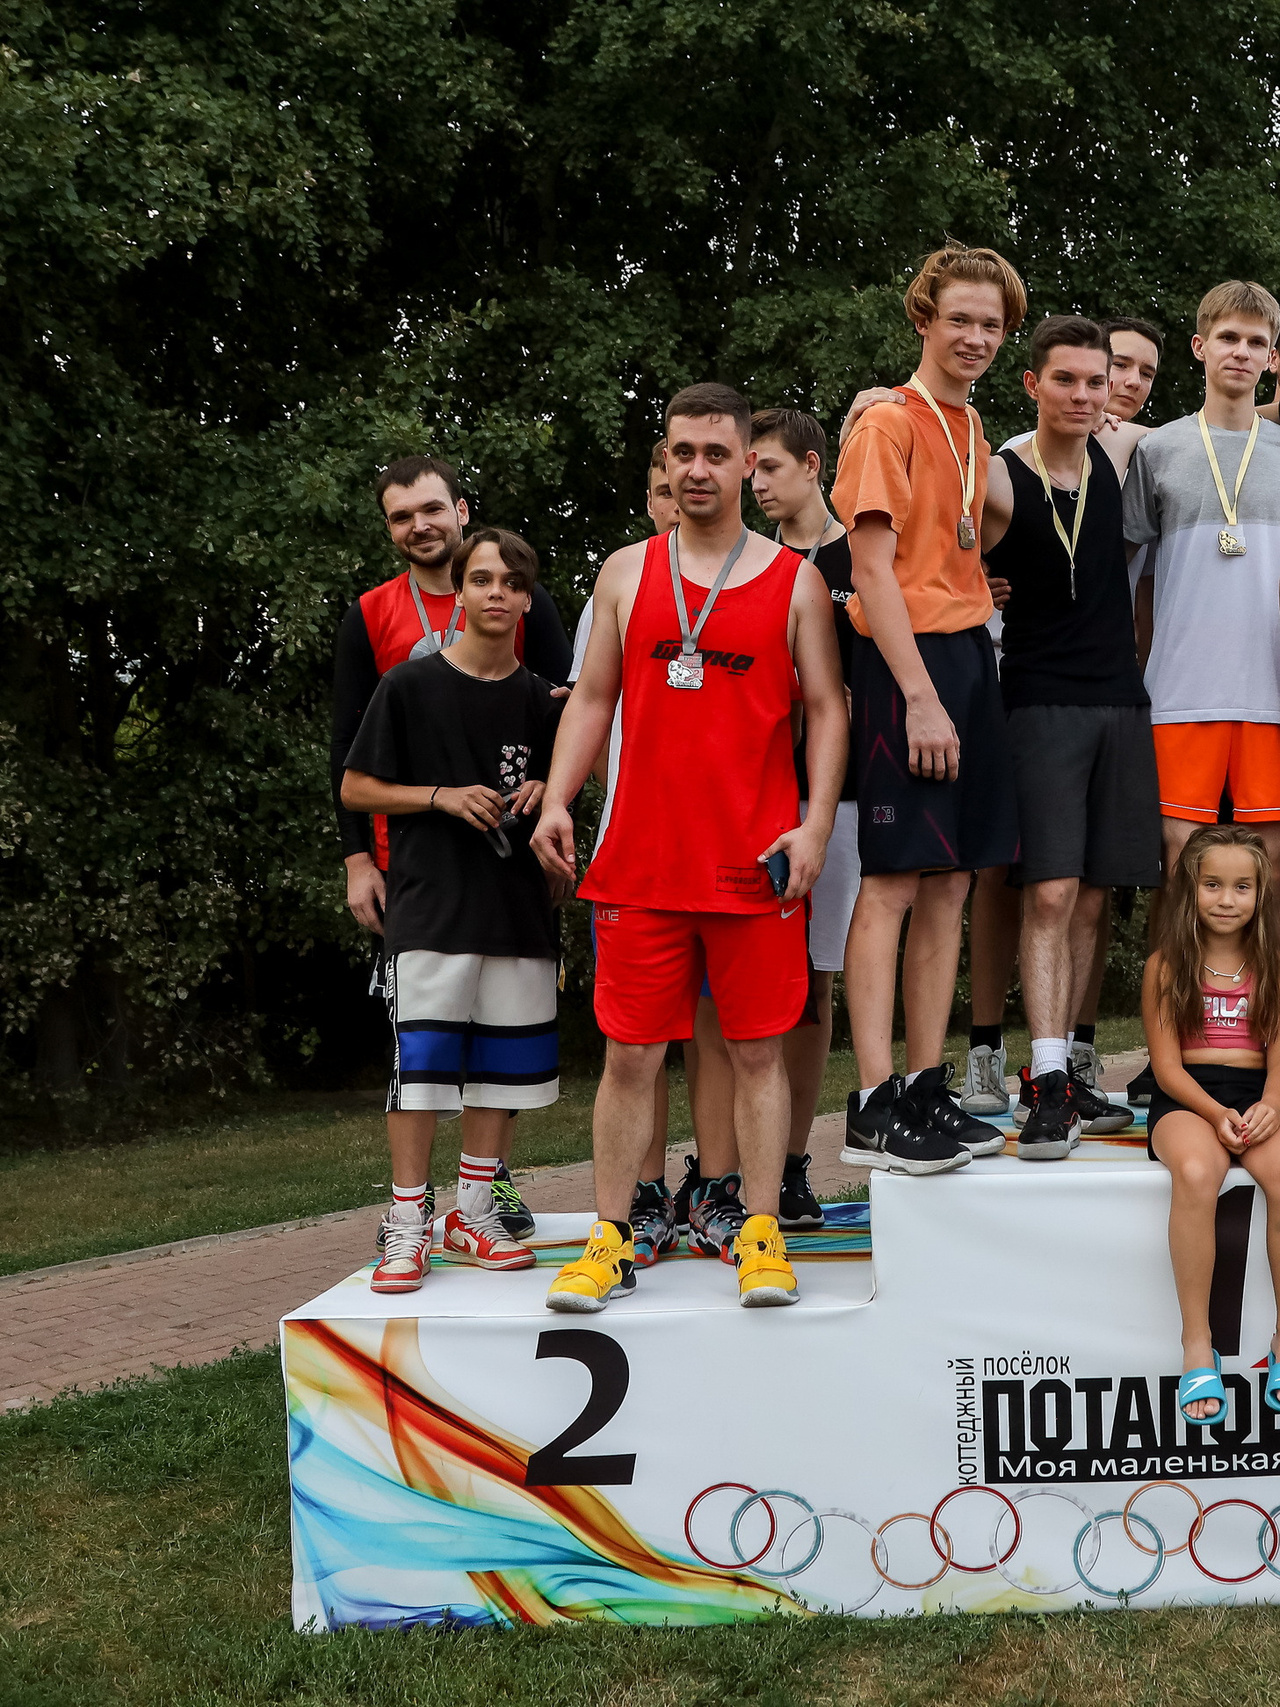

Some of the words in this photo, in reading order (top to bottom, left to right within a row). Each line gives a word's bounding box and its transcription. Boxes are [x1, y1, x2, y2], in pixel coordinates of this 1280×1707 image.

[1203, 996, 1249, 1018] FILA
[983, 1350, 1071, 1377] посёлок
[525, 1328, 637, 1486] 2
[947, 1357, 982, 1486] коттеджный
[998, 1455, 1077, 1479] Моя
